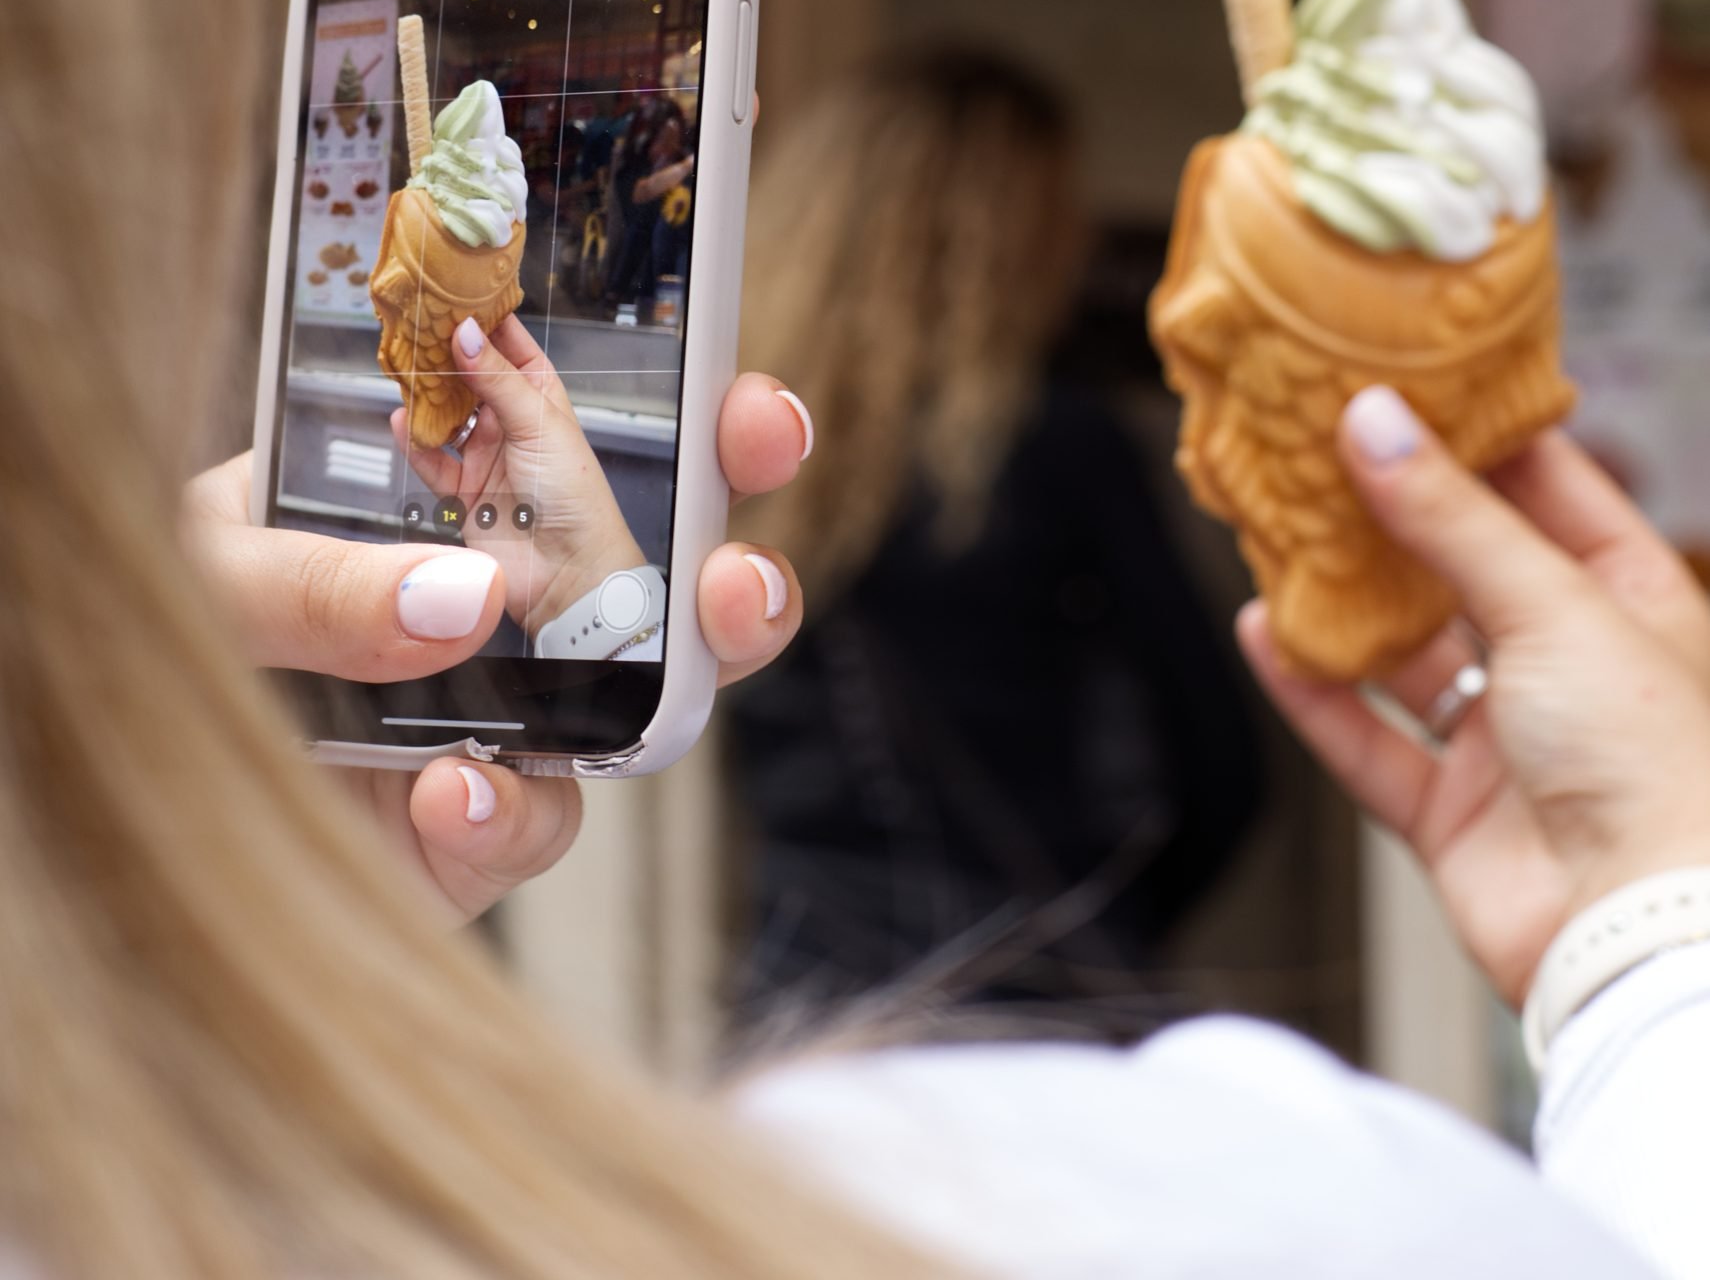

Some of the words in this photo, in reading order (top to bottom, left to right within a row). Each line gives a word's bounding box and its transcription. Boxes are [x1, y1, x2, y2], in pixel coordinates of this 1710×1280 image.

[408, 510, 419, 521] .5
[482, 511, 490, 522] 2
[519, 511, 528, 522] 5
